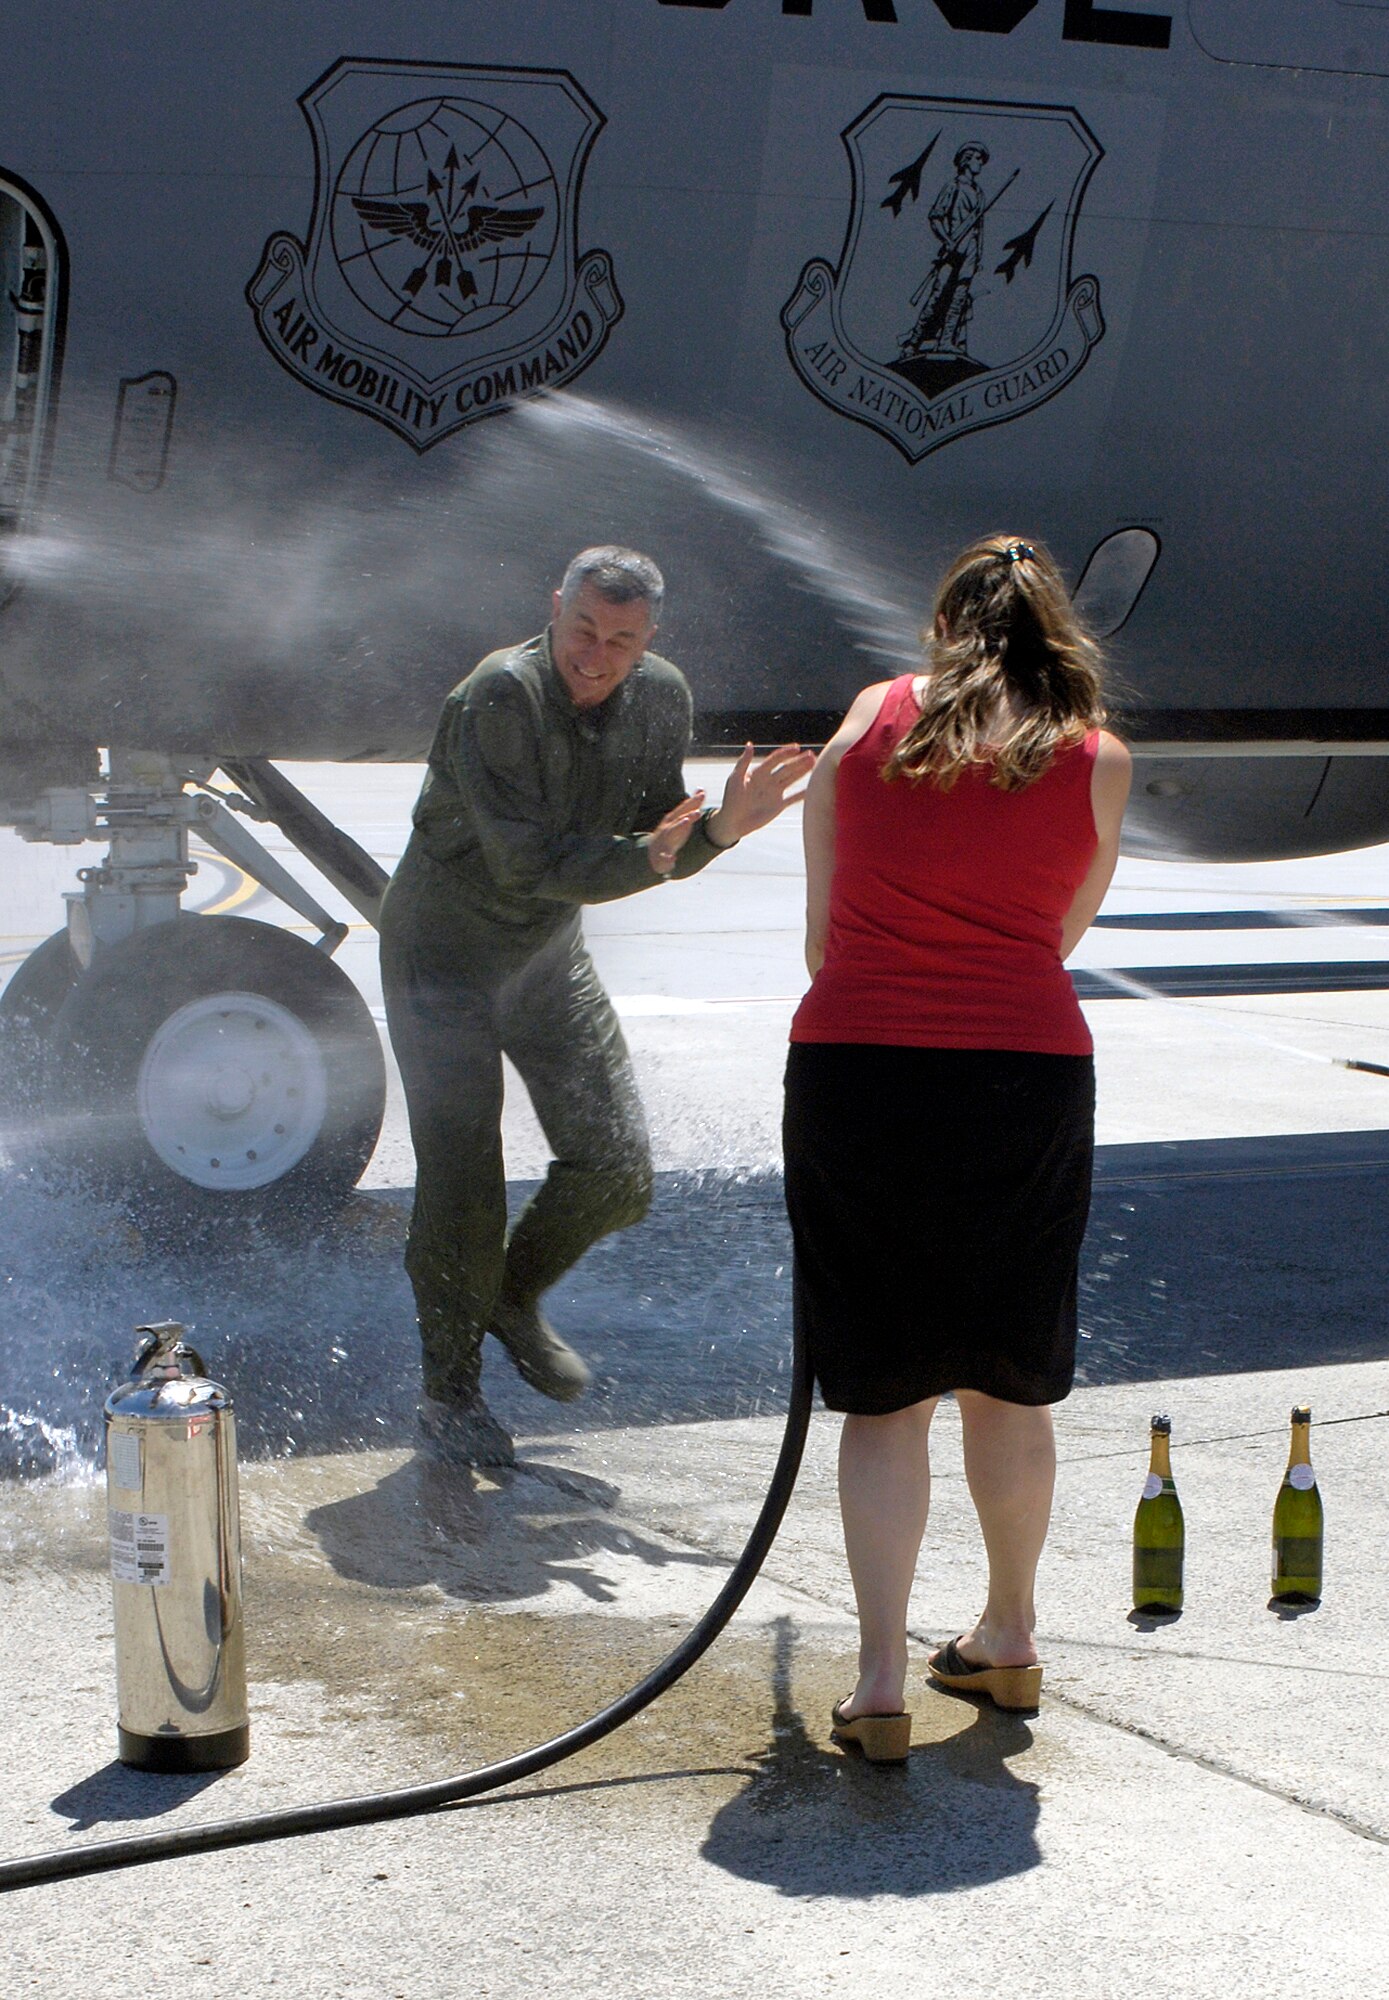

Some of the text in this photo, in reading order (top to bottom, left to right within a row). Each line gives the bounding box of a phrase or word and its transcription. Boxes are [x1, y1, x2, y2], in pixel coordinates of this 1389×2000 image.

[273, 298, 595, 428] AIR MOBILITY COMMAND
[804, 341, 1070, 440] AIR NATIONAL GUARD
